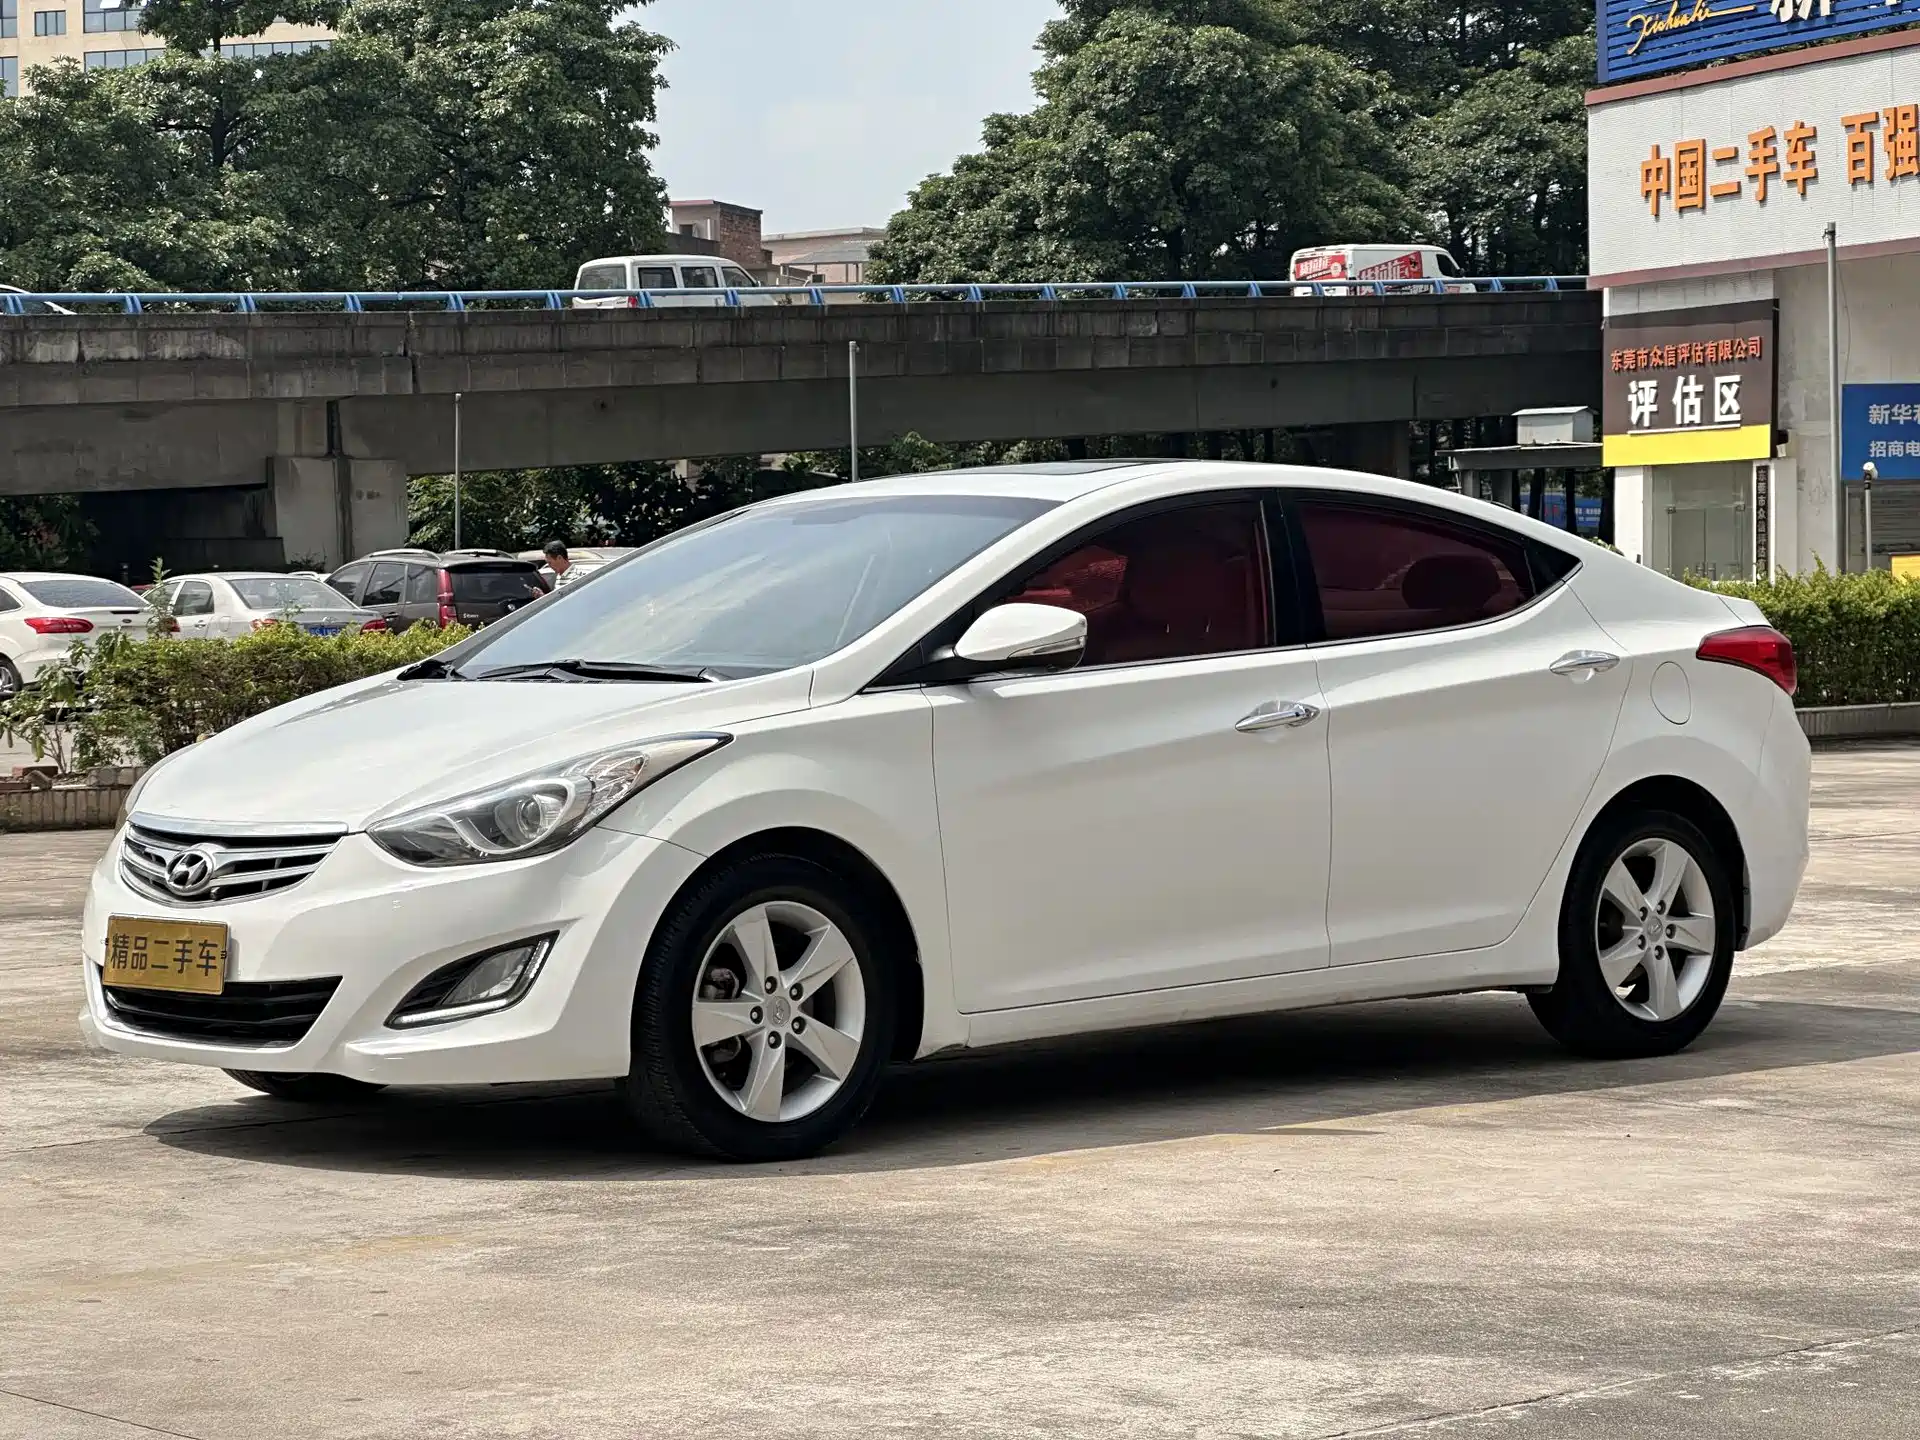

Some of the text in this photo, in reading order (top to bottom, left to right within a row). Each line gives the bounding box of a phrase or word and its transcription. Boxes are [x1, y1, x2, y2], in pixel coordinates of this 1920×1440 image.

[1640, 103, 1919, 216] 中国二手车 百强
[1610, 335, 1762, 371] 东莞市众信评估有限公司
[1627, 374, 1742, 428] 评估区
[111, 933, 218, 977] 精品二手车
